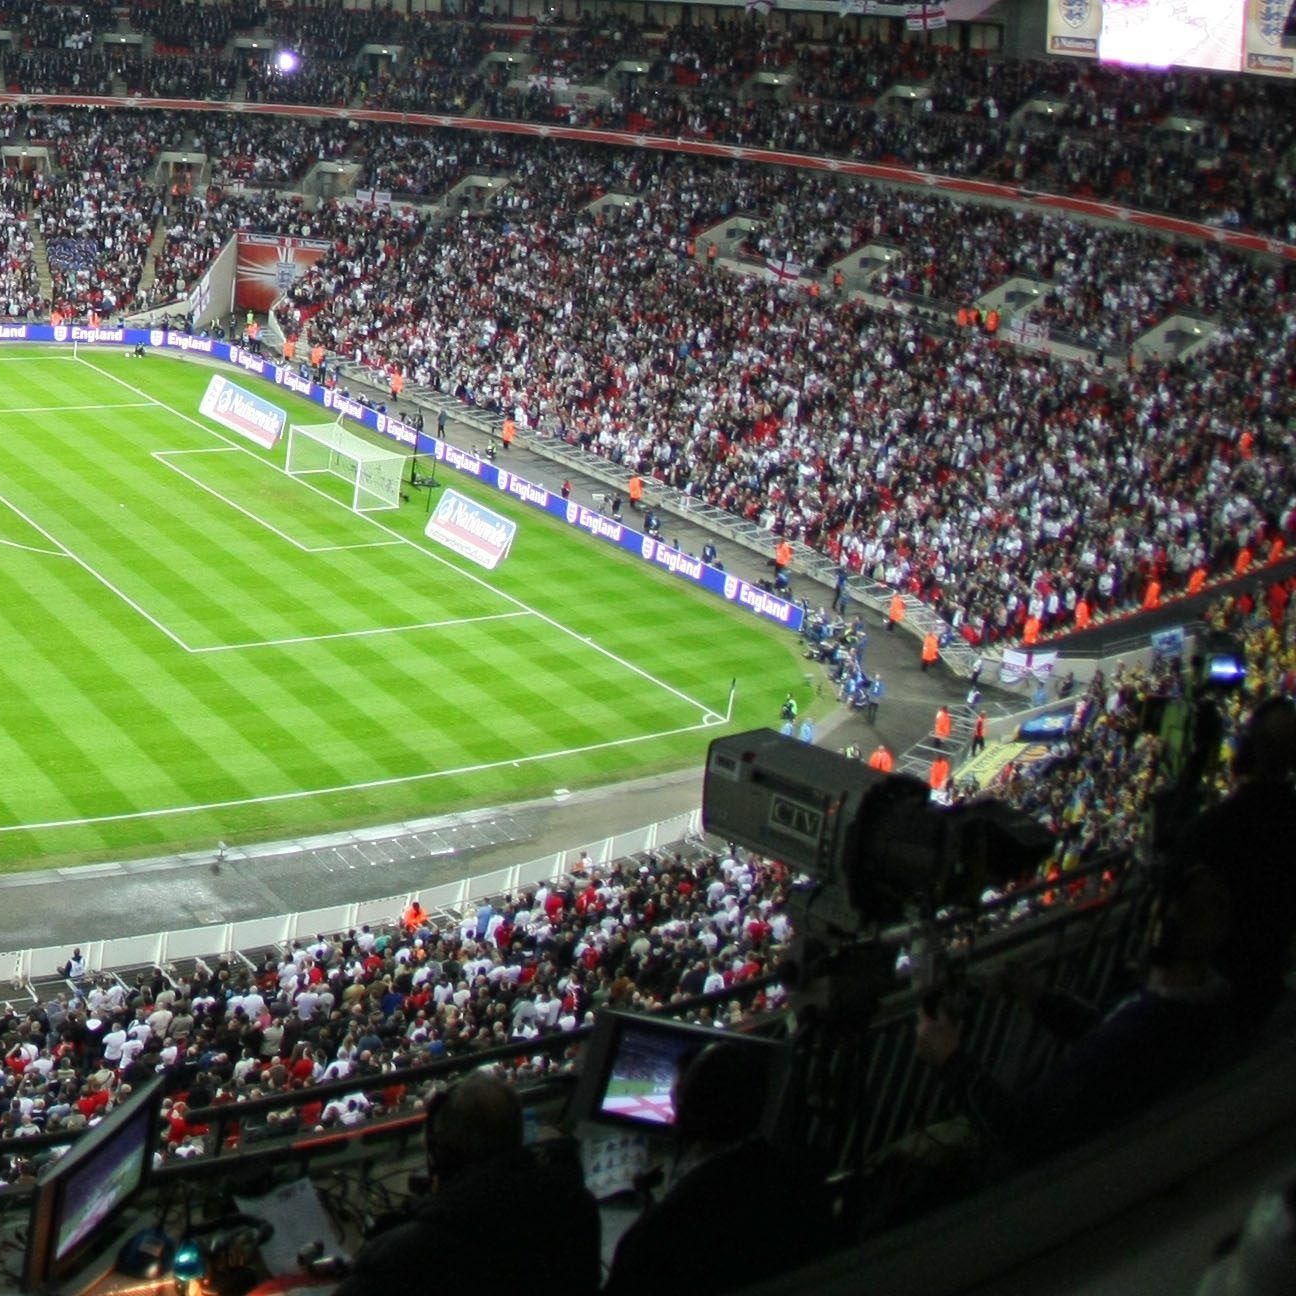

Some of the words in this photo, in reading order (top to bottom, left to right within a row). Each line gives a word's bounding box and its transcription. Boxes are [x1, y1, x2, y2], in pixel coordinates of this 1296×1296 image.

[71, 326, 123, 343] England
[167, 331, 211, 352] England
[236, 352, 264, 373] England
[283, 372, 311, 394] England
[228, 392, 279, 434] Nationwide
[333, 392, 362, 419] England
[446, 444, 480, 474] England
[509, 476, 547, 506] England
[450, 500, 507, 548] Nationwide
[579, 508, 621, 542] England
[657, 544, 702, 579] England
[740, 583, 789, 621] England
